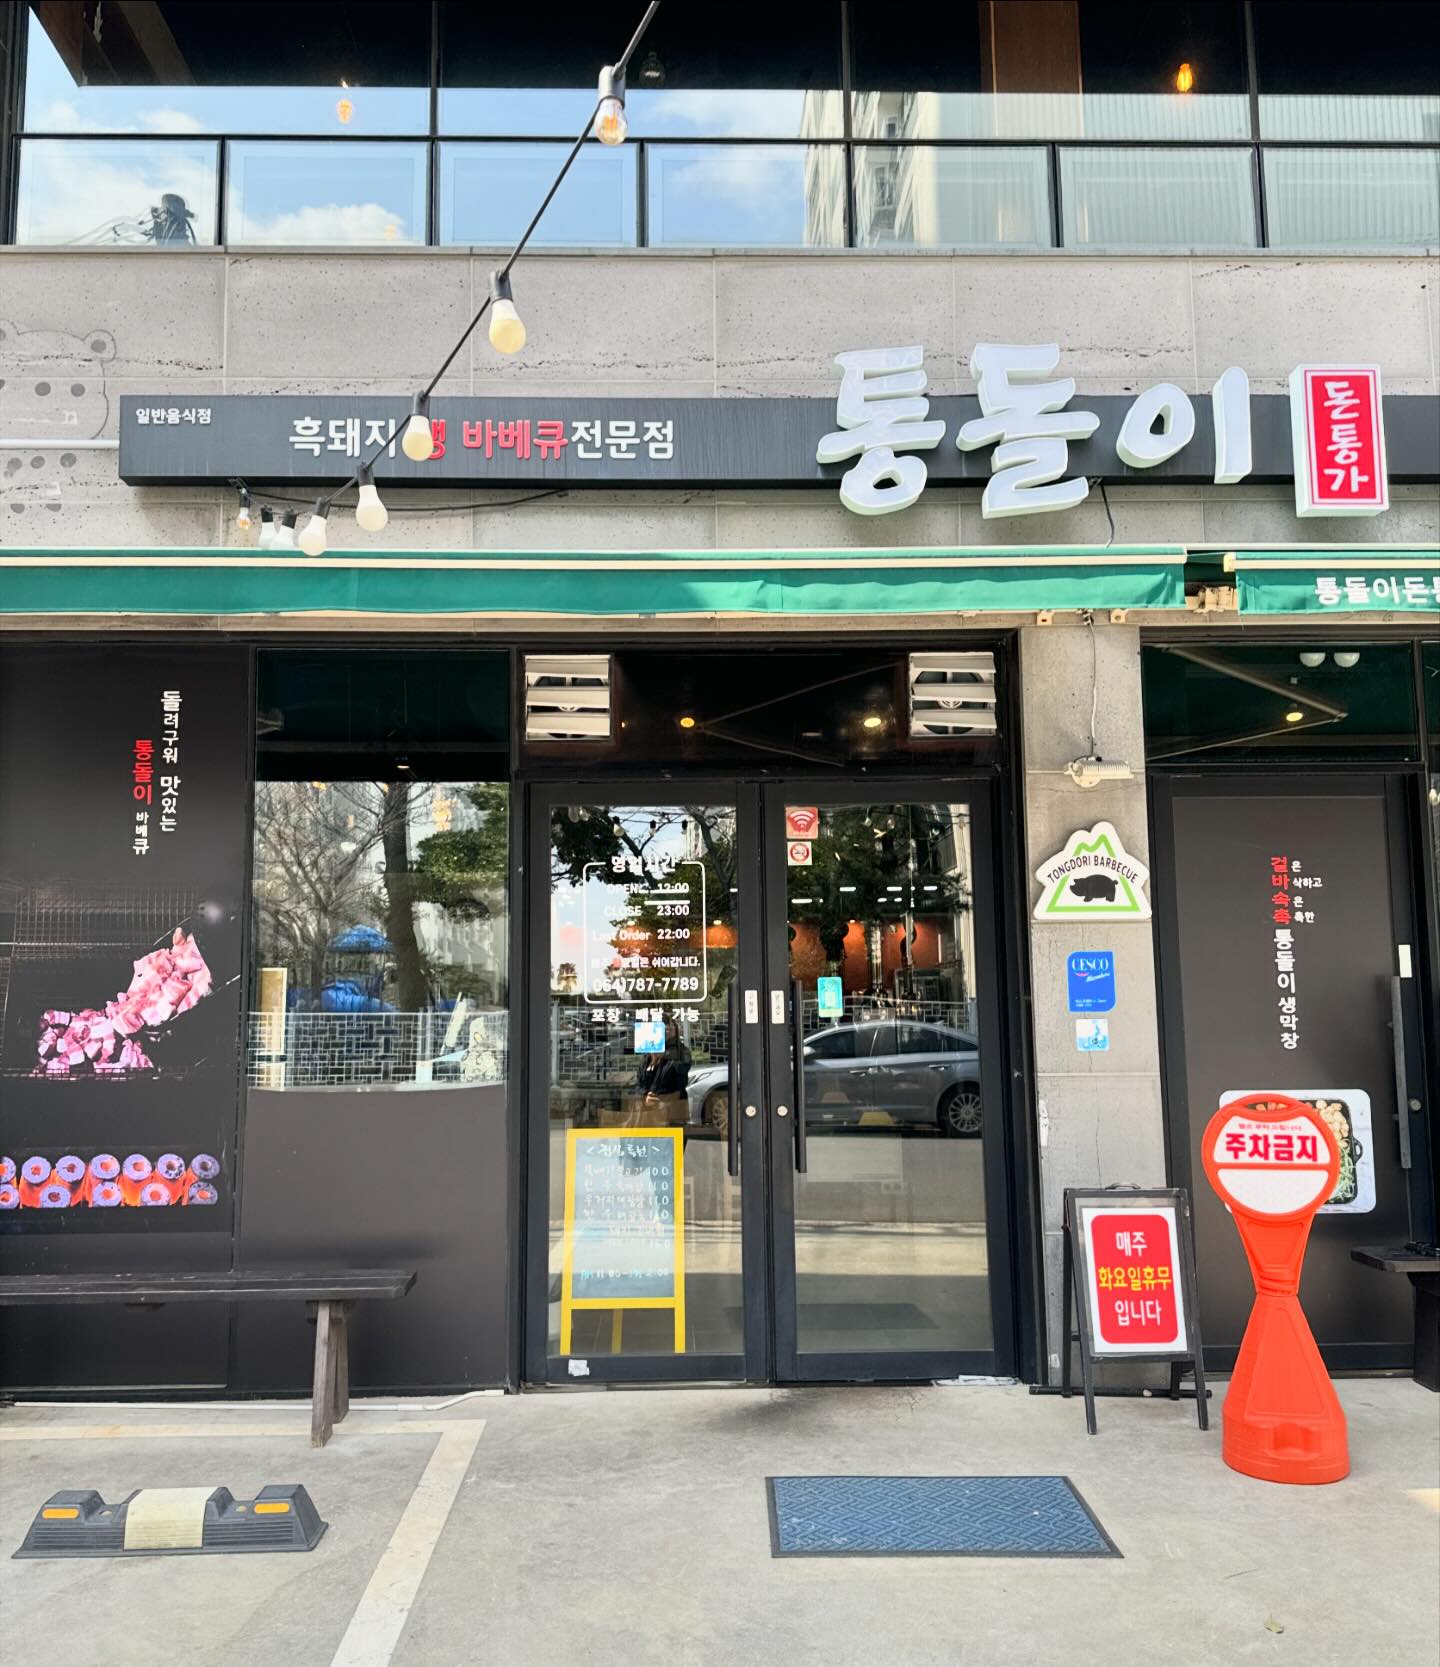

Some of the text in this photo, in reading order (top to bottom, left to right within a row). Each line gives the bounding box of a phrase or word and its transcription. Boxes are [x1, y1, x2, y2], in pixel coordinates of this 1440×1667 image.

[135, 408, 212, 425] 일반음식점
[288, 416, 396, 458] 흑돼지
[815, 343, 1252, 519] 통돌이
[1323, 381, 1369, 492] 돈통가
[159, 690, 183, 832] 돌려구워 맛있는
[132, 740, 154, 855] 통돌이 바베큐
[1047, 855, 1139, 884] TONGDORI BARBECUE
[656, 882, 690, 894] 12:00
[656, 904, 690, 916] 23:00
[619, 928, 652, 941] Order
[656, 928, 691, 940] 22:00
[1071, 958, 1109, 971] CESCO
[591, 976, 699, 993] 064)787-7789
[591, 1007, 701, 1023] 포장 배달 가능
[1225, 1132, 1319, 1162] 주차금지
[1115, 1231, 1148, 1257] 매주
[1097, 1266, 1172, 1292] 화요일휴무
[1114, 1299, 1162, 1326] 입니다
